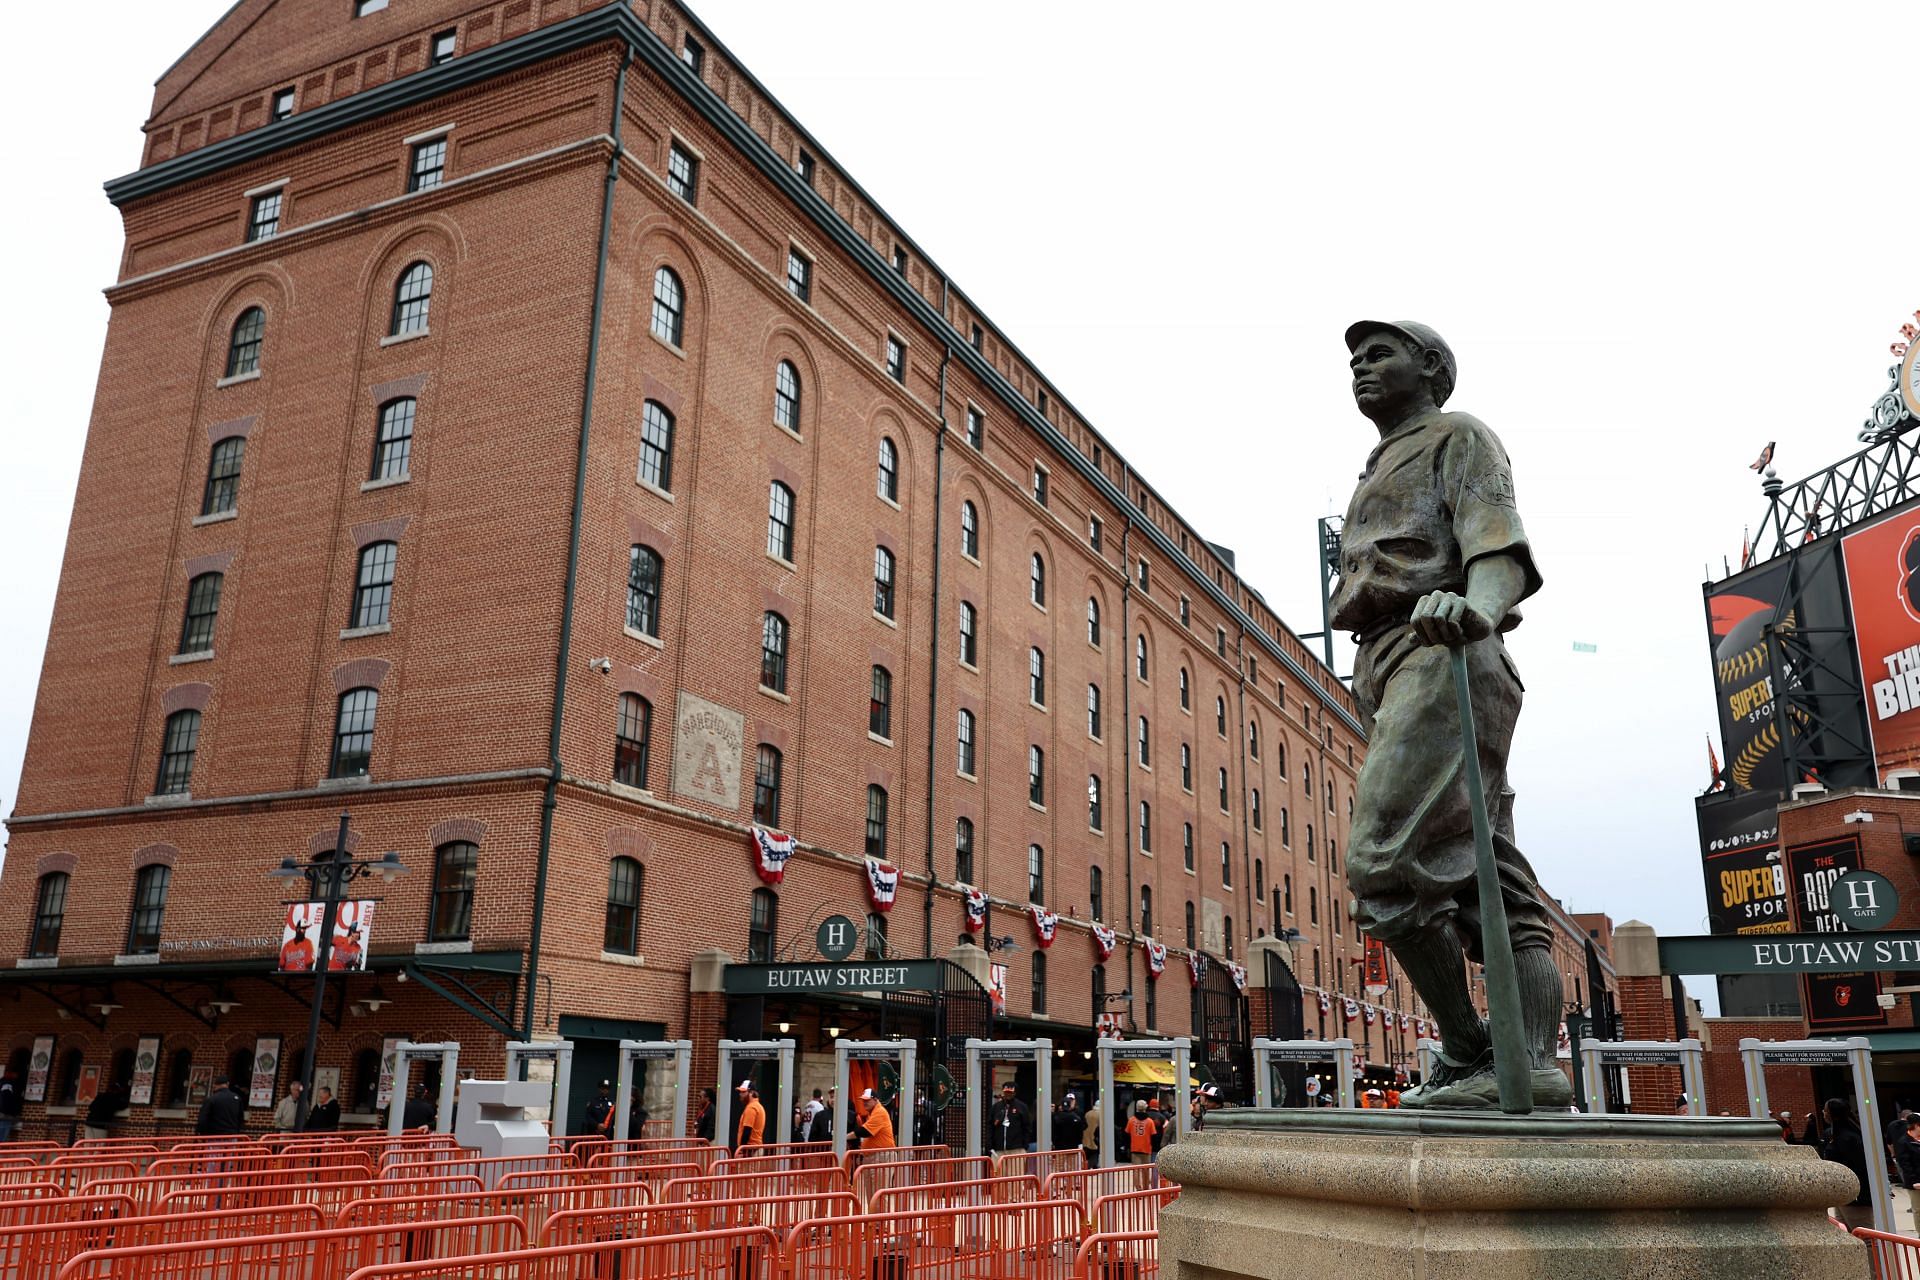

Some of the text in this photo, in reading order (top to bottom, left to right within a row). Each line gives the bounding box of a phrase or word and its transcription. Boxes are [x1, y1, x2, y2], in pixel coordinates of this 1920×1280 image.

[680, 711, 740, 757] WAREHOUSE
[691, 742, 726, 796] A
[1814, 856, 1835, 867] THE
[1844, 880, 1880, 909] H
[1853, 909, 1877, 917] GATE
[826, 923, 846, 946] H
[1752, 941, 1864, 966] EUTAW
[767, 967, 909, 987] EUTAW STREET
